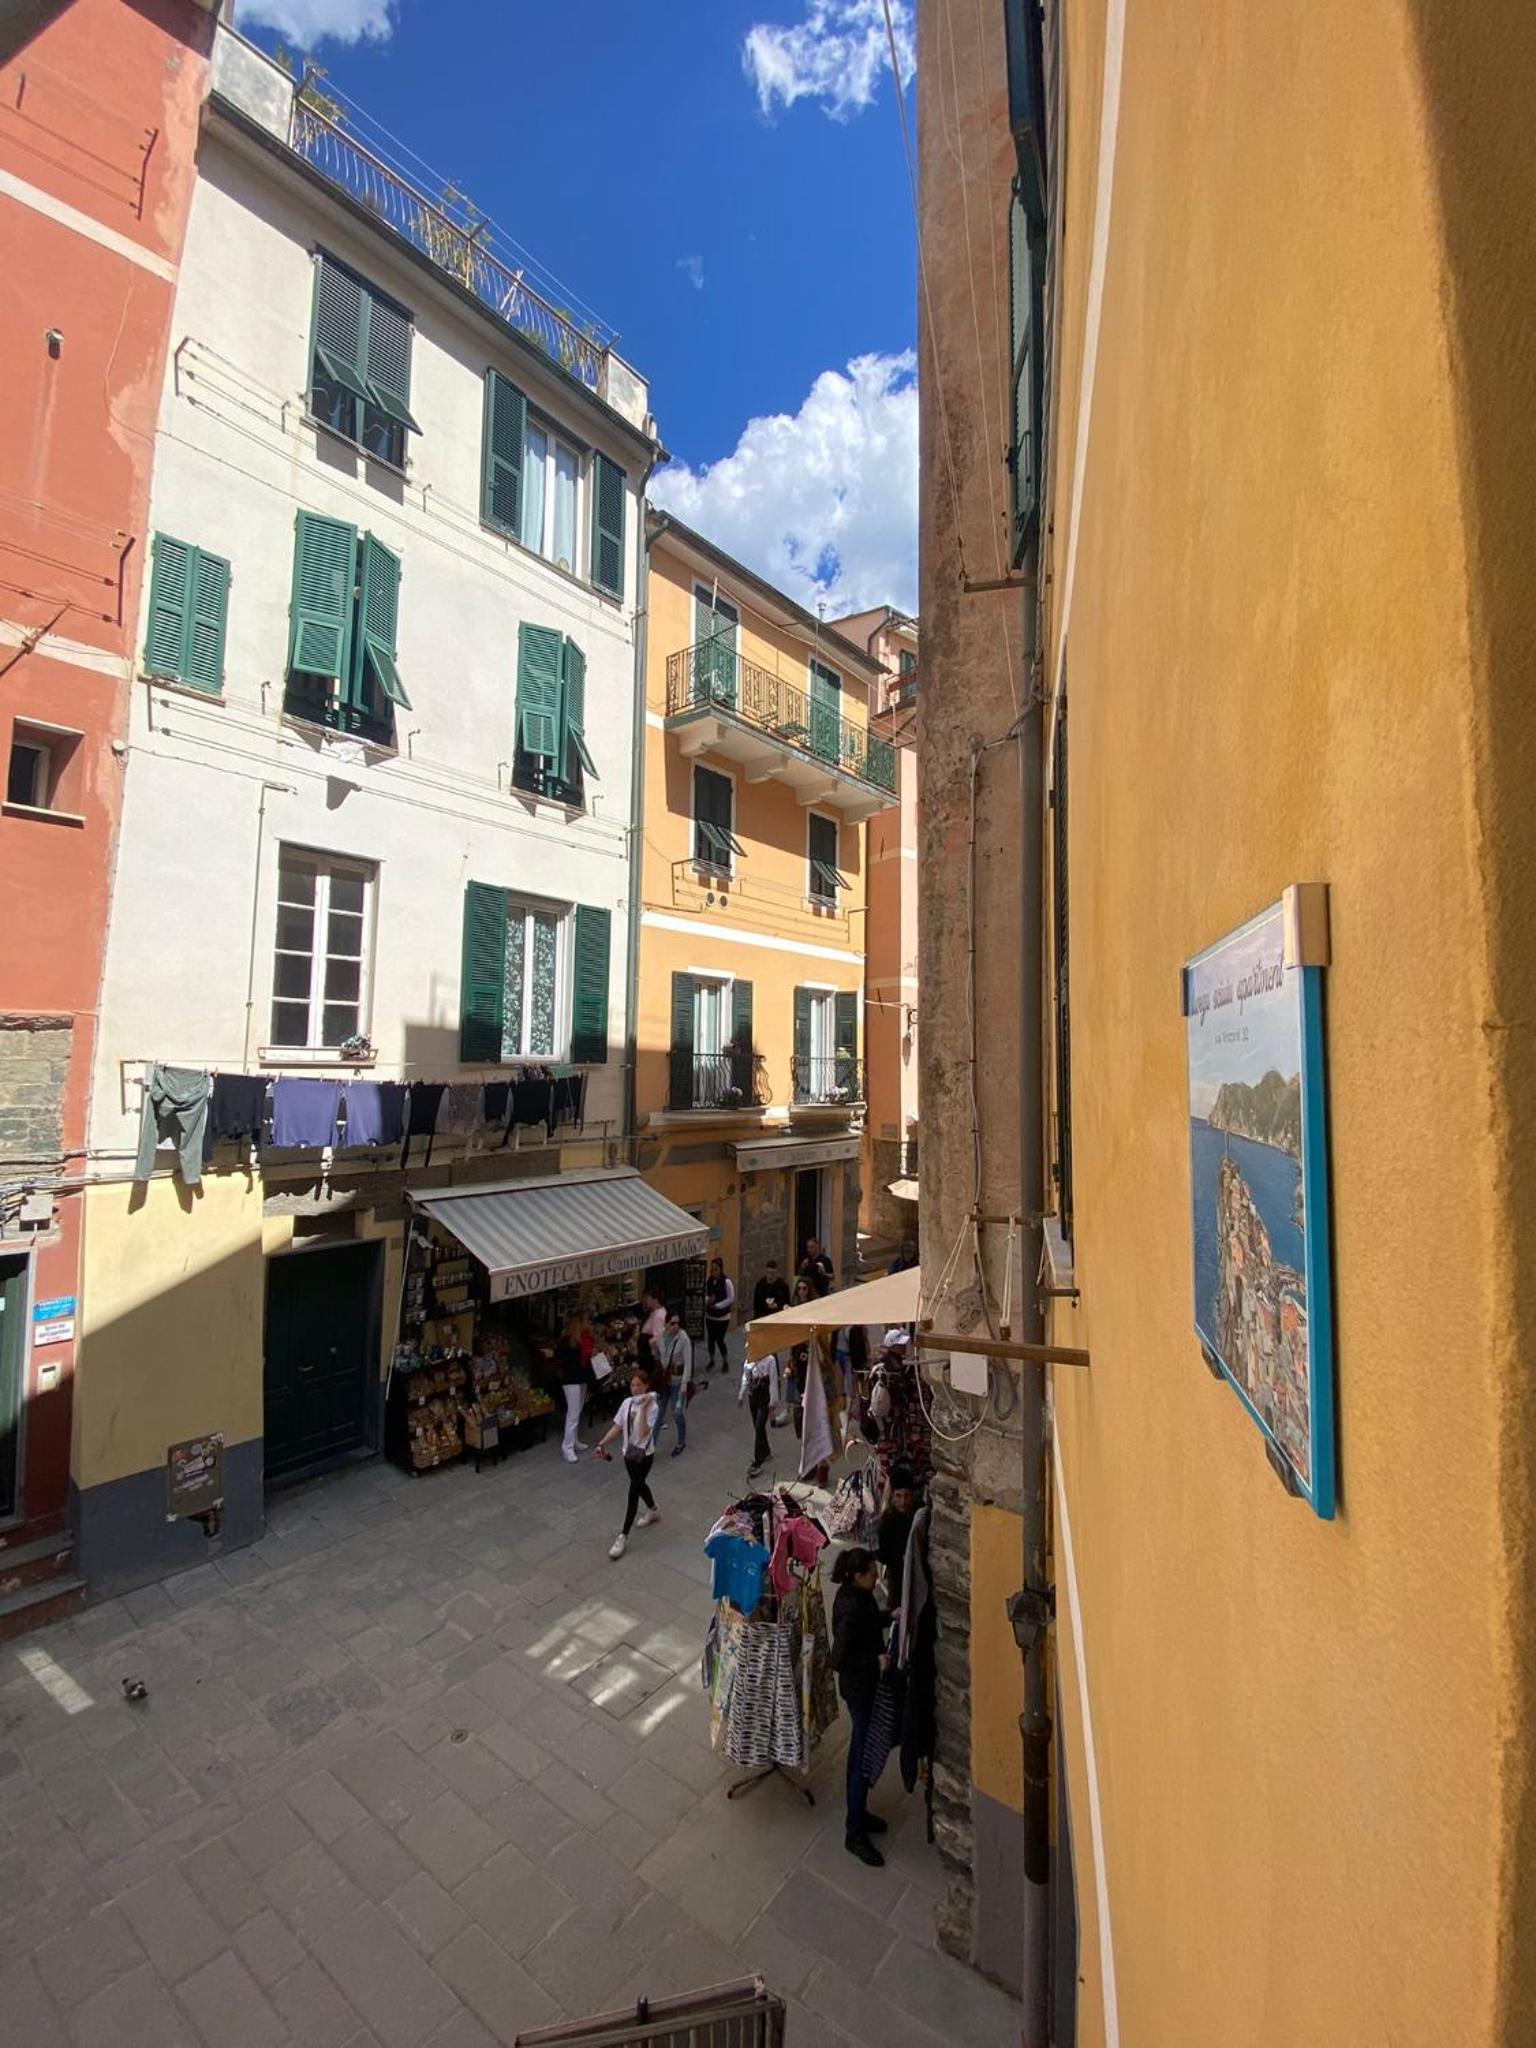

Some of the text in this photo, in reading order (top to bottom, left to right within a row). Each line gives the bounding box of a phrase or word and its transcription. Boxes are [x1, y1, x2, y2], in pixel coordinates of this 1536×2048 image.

[504, 1262, 582, 1295] ENOTECA
[607, 1252, 650, 1273] Cantina
[653, 1244, 668, 1263] del
